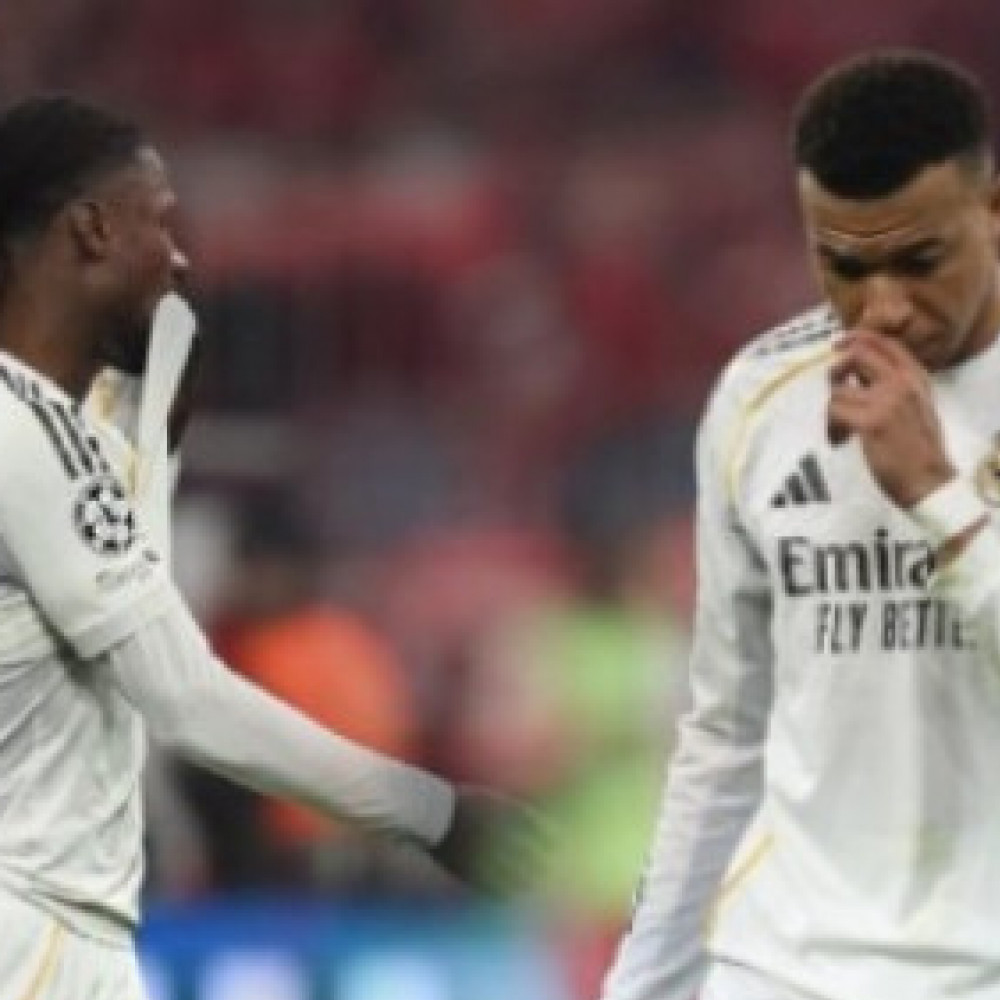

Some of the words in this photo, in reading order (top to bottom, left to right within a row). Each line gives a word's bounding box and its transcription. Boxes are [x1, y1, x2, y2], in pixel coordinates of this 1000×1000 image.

[778, 528, 936, 598] Emira
[816, 602, 868, 655] FLY
[881, 598, 977, 652] BETTE
